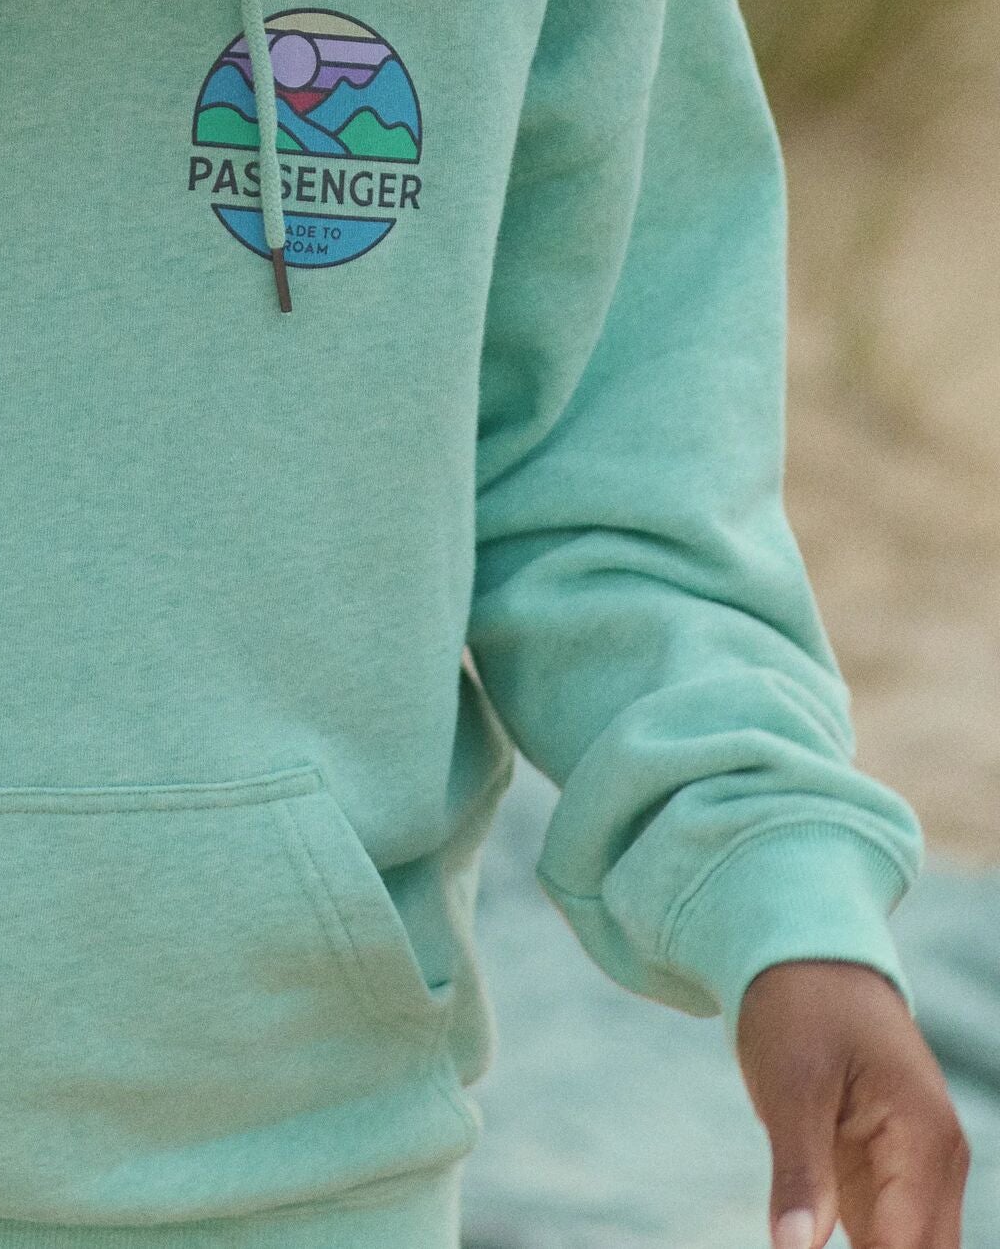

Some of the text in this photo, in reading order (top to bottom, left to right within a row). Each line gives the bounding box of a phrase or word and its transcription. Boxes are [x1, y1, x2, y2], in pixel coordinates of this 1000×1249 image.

[187, 156, 423, 210] PASSENGER
[285, 224, 342, 240] ADE TO
[284, 240, 329, 255] ROAM
